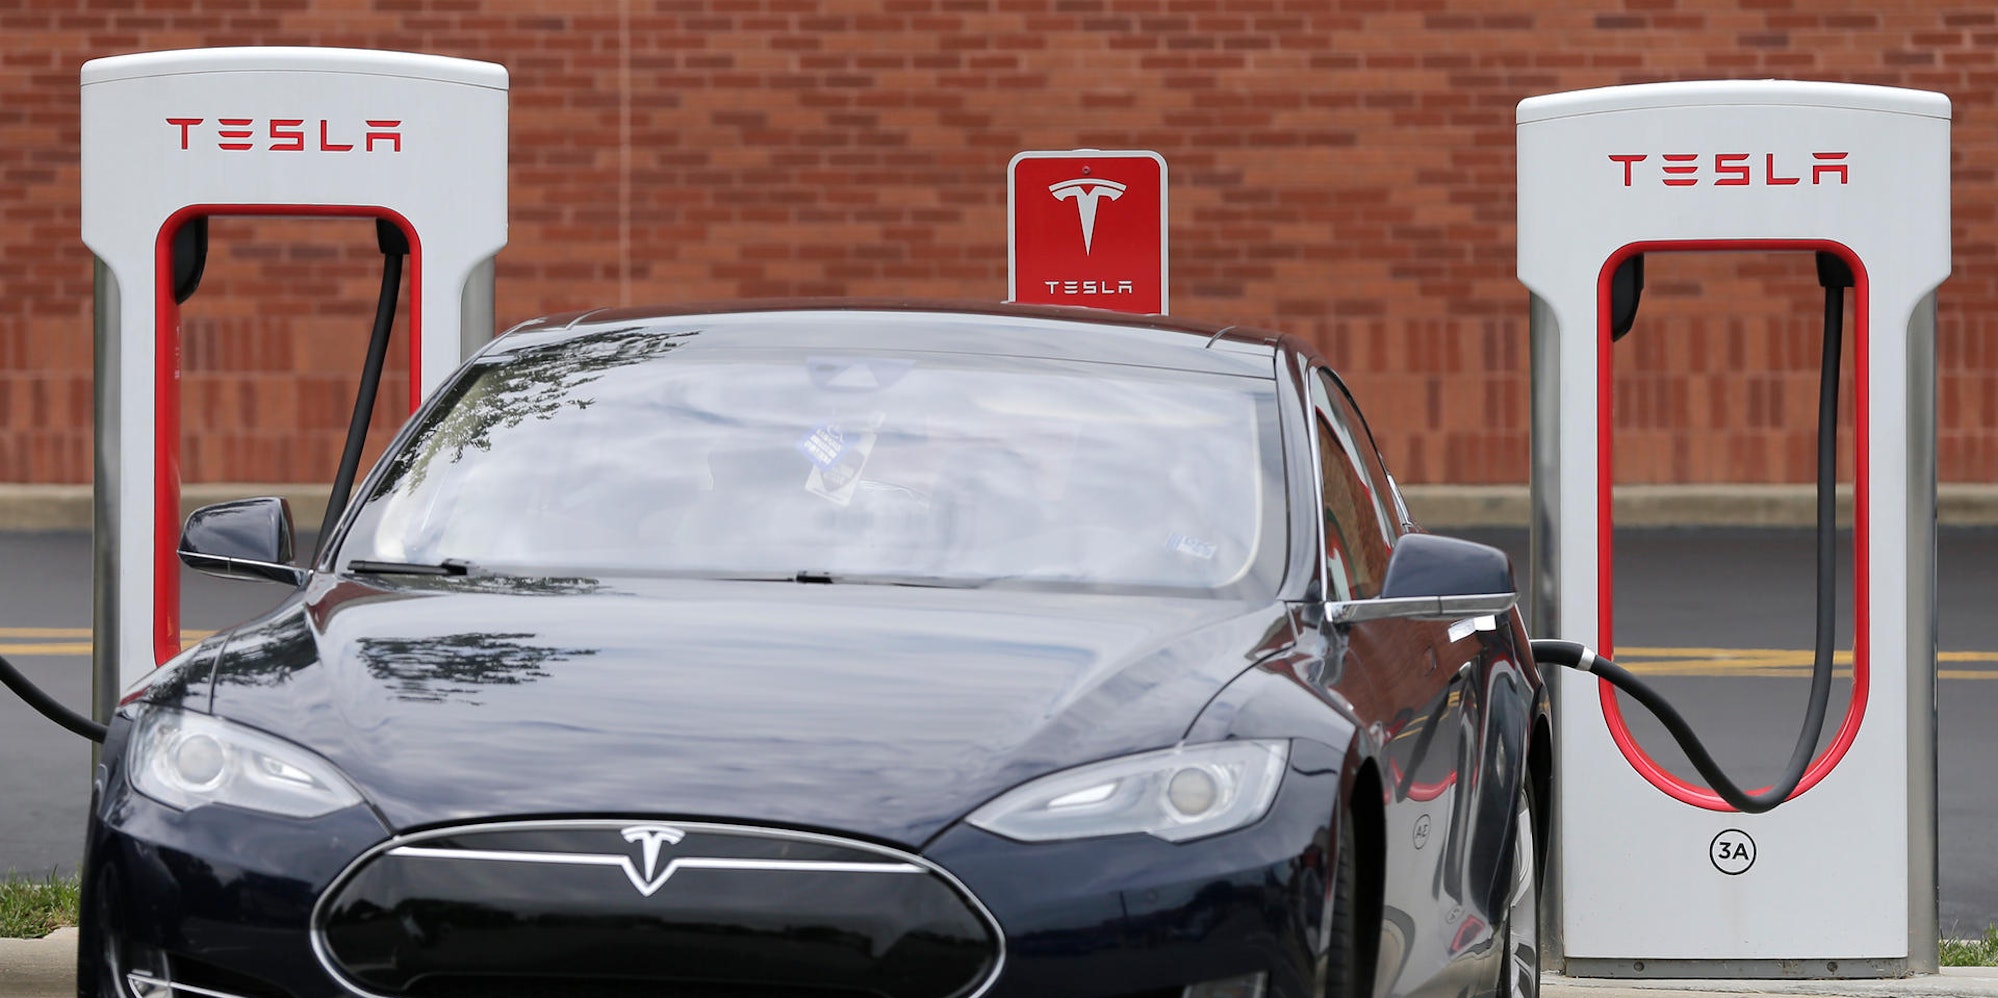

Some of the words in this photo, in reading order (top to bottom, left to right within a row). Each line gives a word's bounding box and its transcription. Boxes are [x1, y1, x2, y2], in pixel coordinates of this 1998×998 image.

[166, 117, 402, 152] TESLA
[1609, 152, 1849, 187] TESLA
[1044, 280, 1133, 294] TESLA
[1718, 842, 1749, 860] 3A
